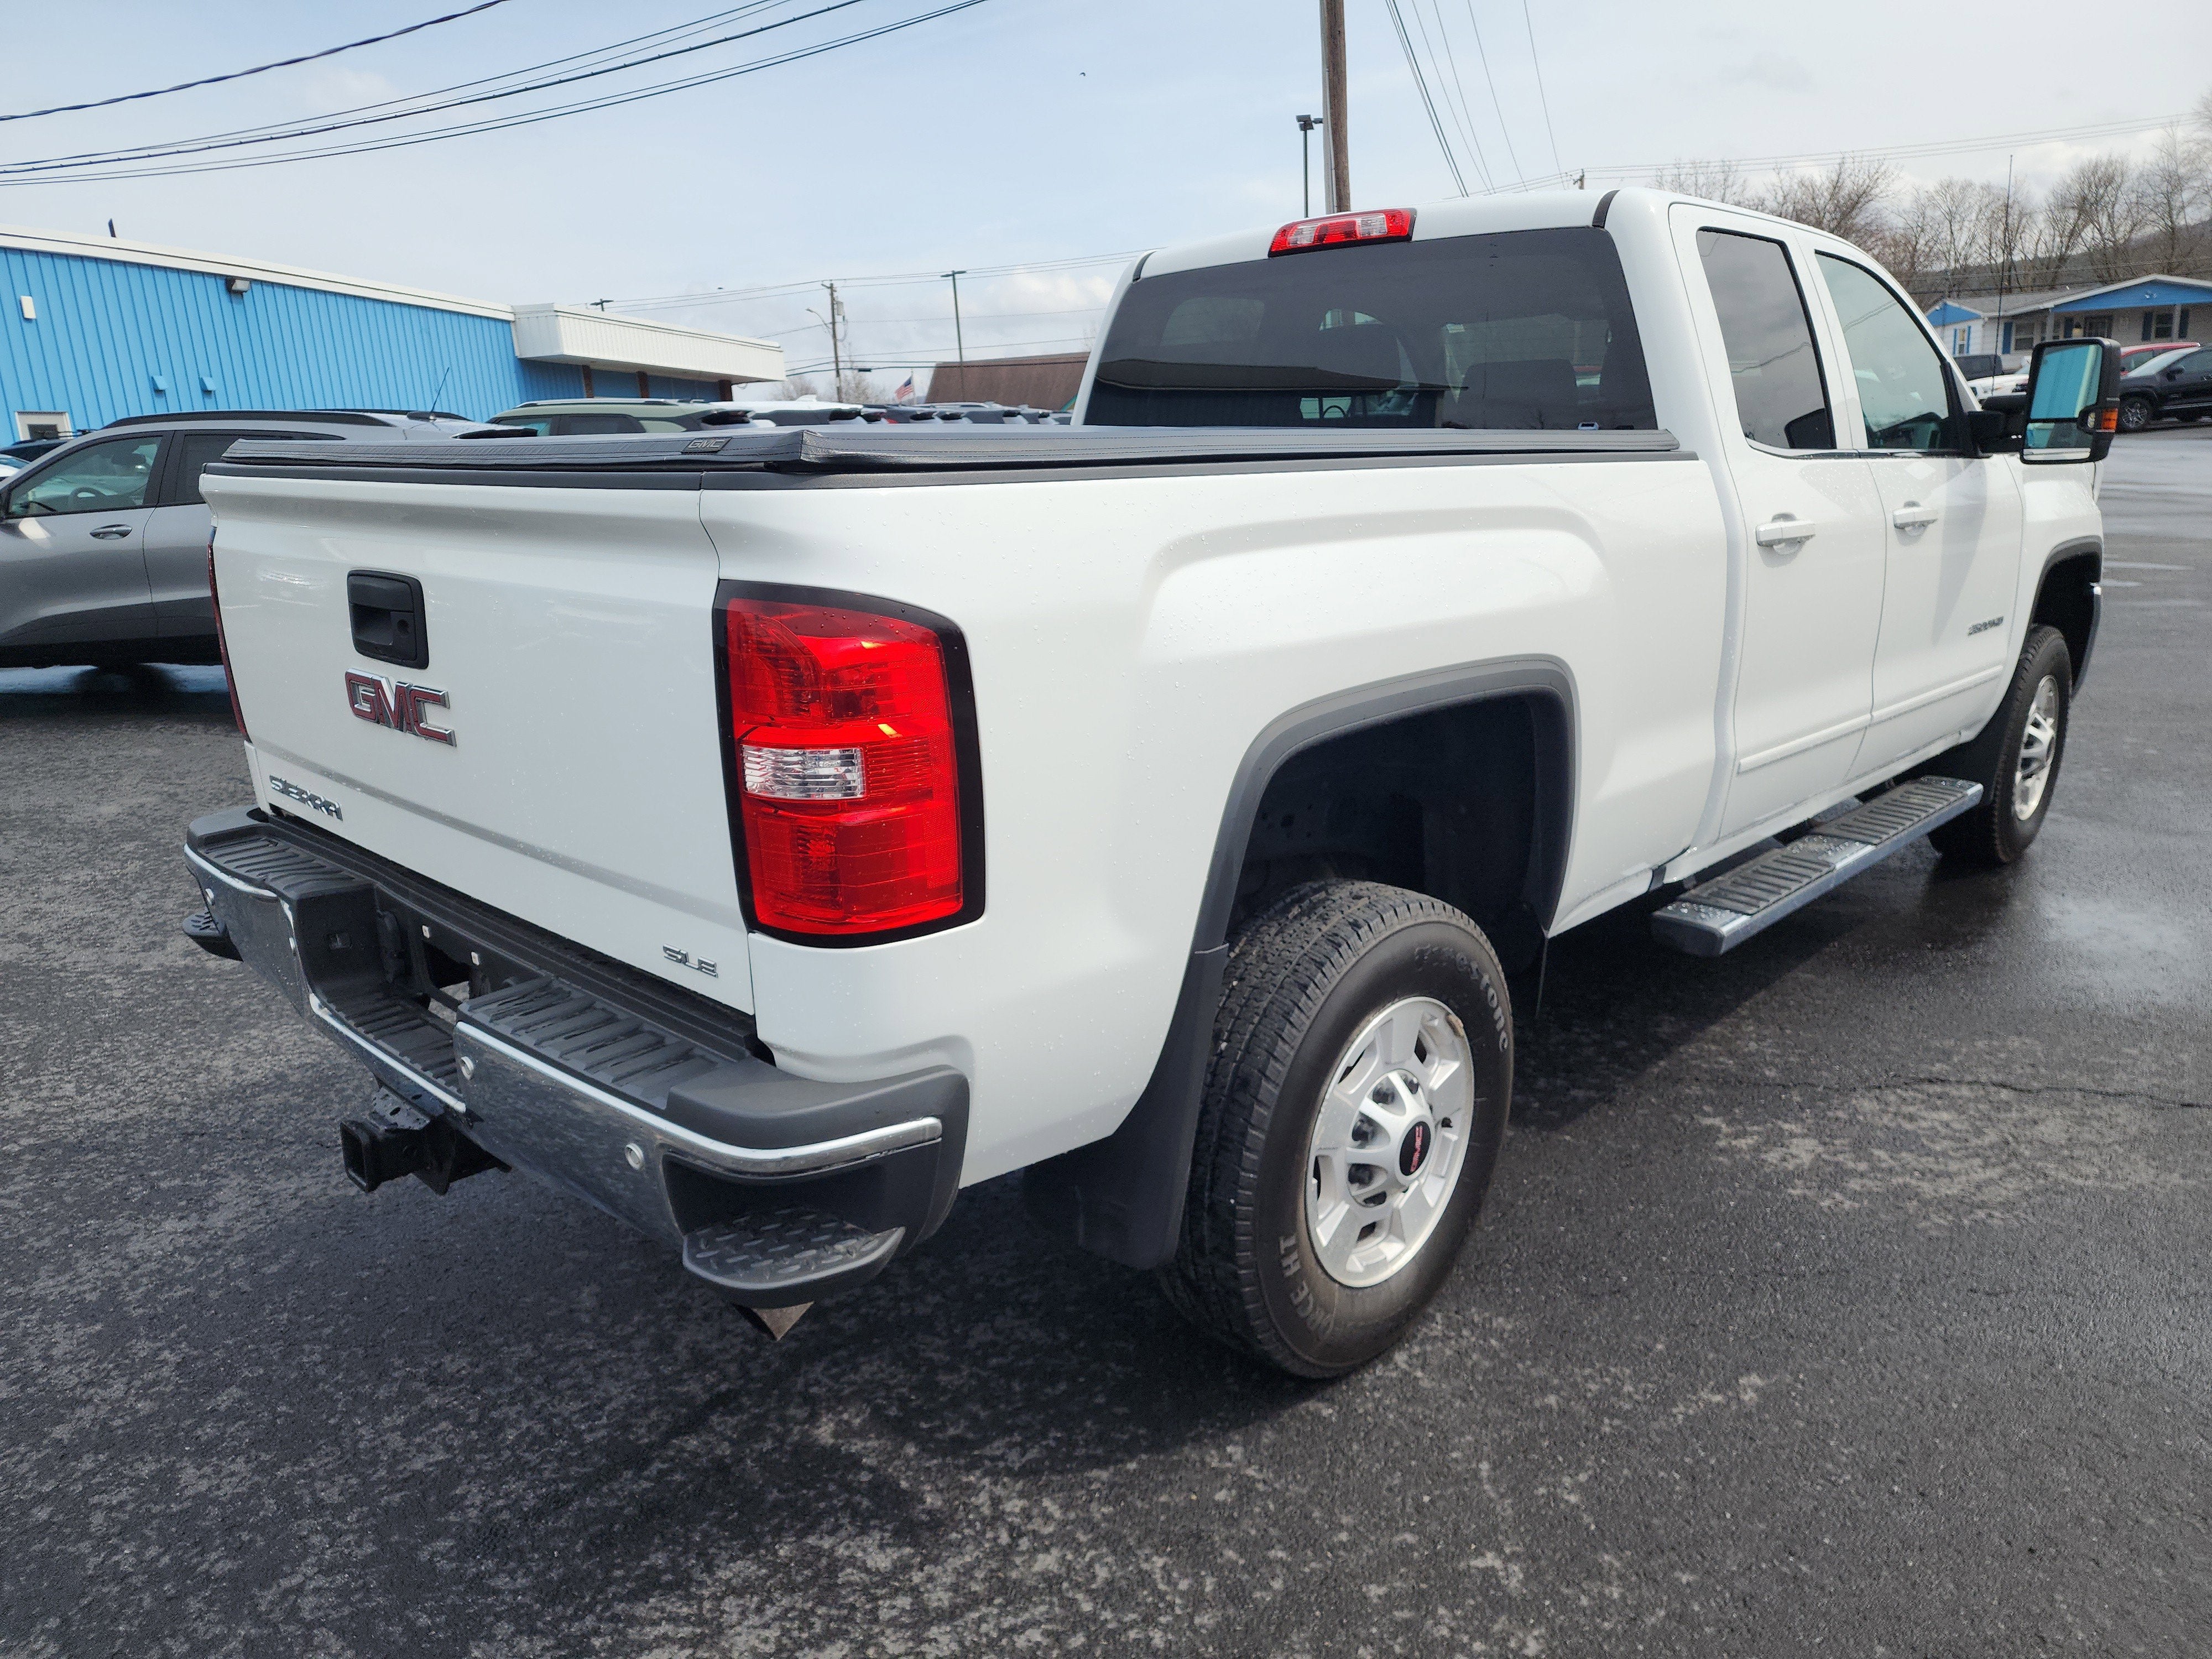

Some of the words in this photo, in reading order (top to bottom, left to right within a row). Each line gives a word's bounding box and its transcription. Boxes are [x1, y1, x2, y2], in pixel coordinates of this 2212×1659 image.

[688, 439, 725, 448] GMC
[345, 668, 457, 747] GMC
[269, 775, 343, 822] SIERRA
[663, 943, 718, 978] SLE
[1279, 1234, 1301, 1277] HT
